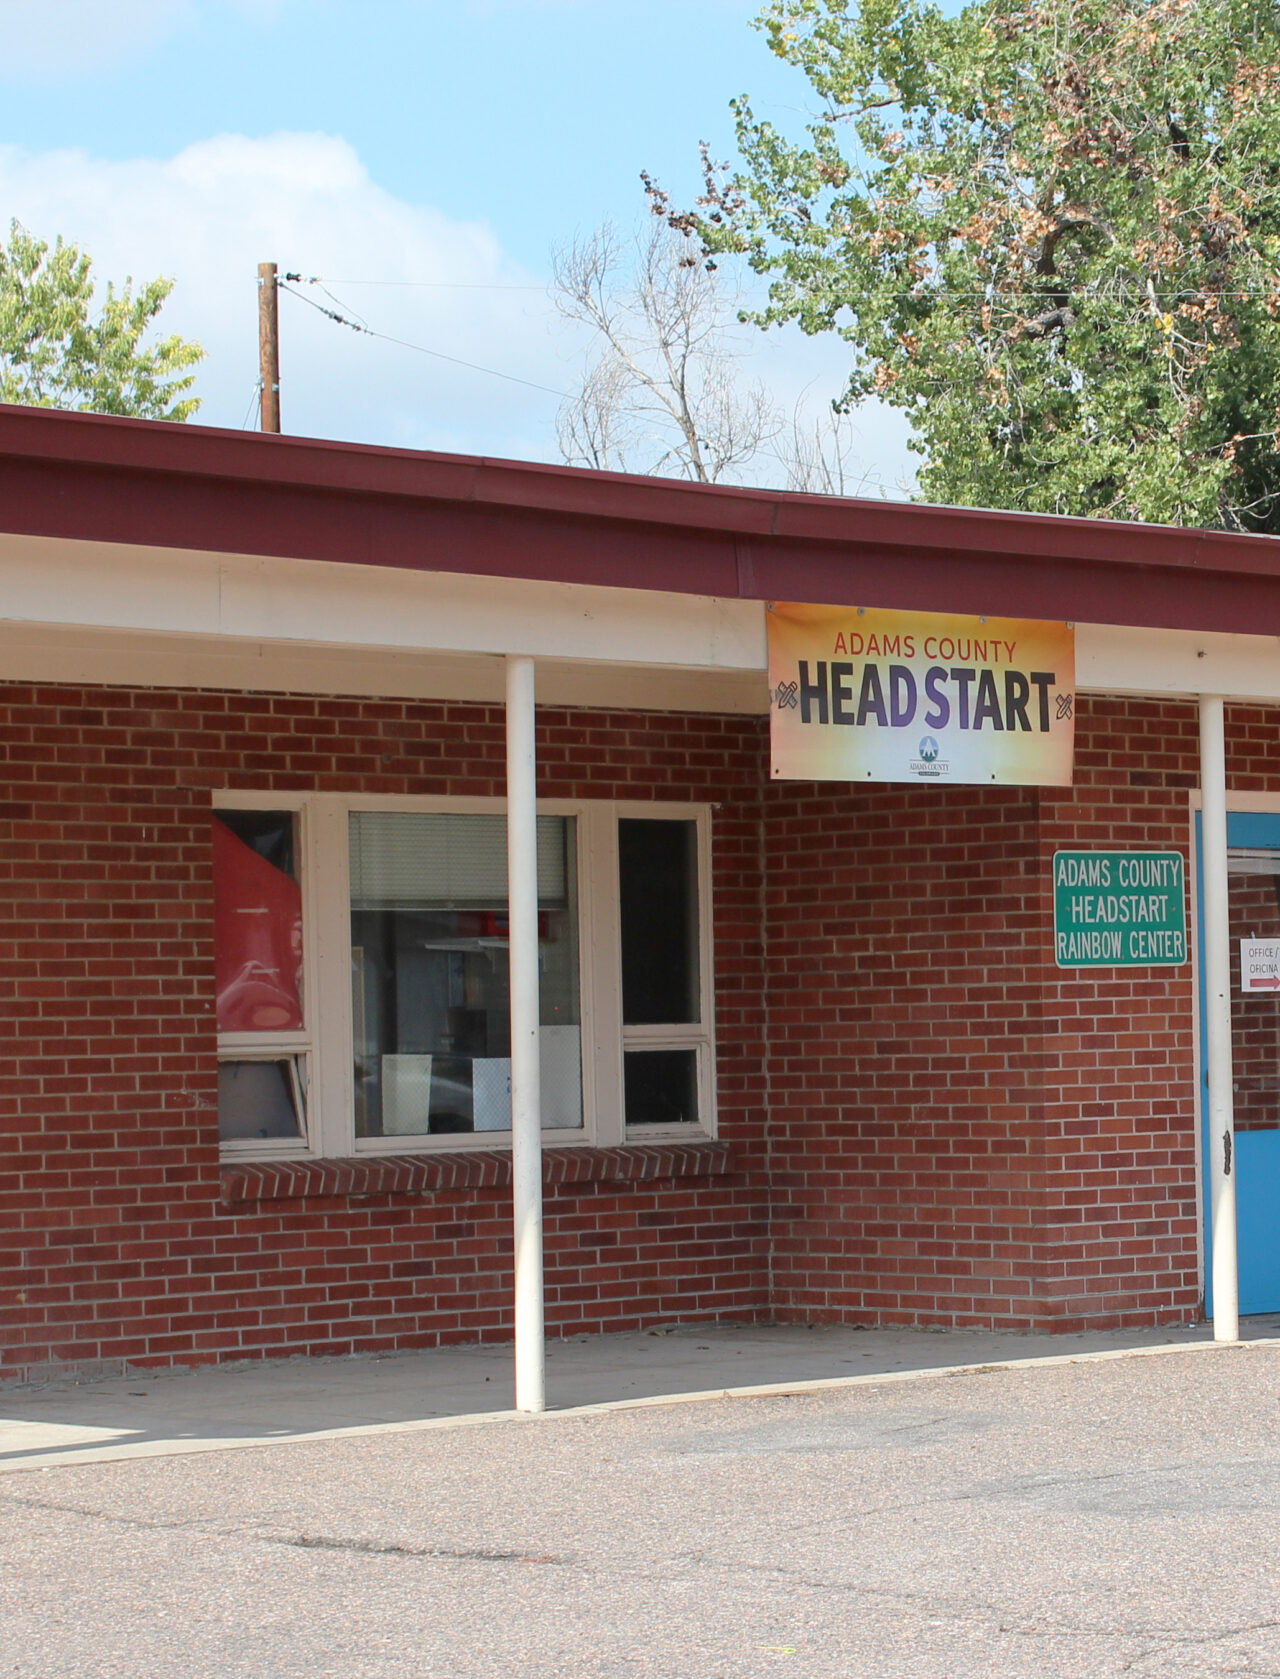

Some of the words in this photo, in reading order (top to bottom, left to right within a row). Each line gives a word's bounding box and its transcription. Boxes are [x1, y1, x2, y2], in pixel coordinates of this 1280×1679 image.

[834, 631, 915, 658] ADAMS
[924, 637, 1017, 663] COUNTY
[798, 660, 917, 728] HEAD
[924, 666, 1055, 732] START
[1057, 859, 1111, 887] ADAMS
[1118, 859, 1179, 888] COUNTY
[1072, 895, 1168, 923] HEADSTART
[1058, 931, 1122, 960] RAINBOW
[1129, 930, 1183, 958] CENTER
[1249, 947, 1273, 958] OFFICE
[1249, 963, 1279, 974] OFICINA
